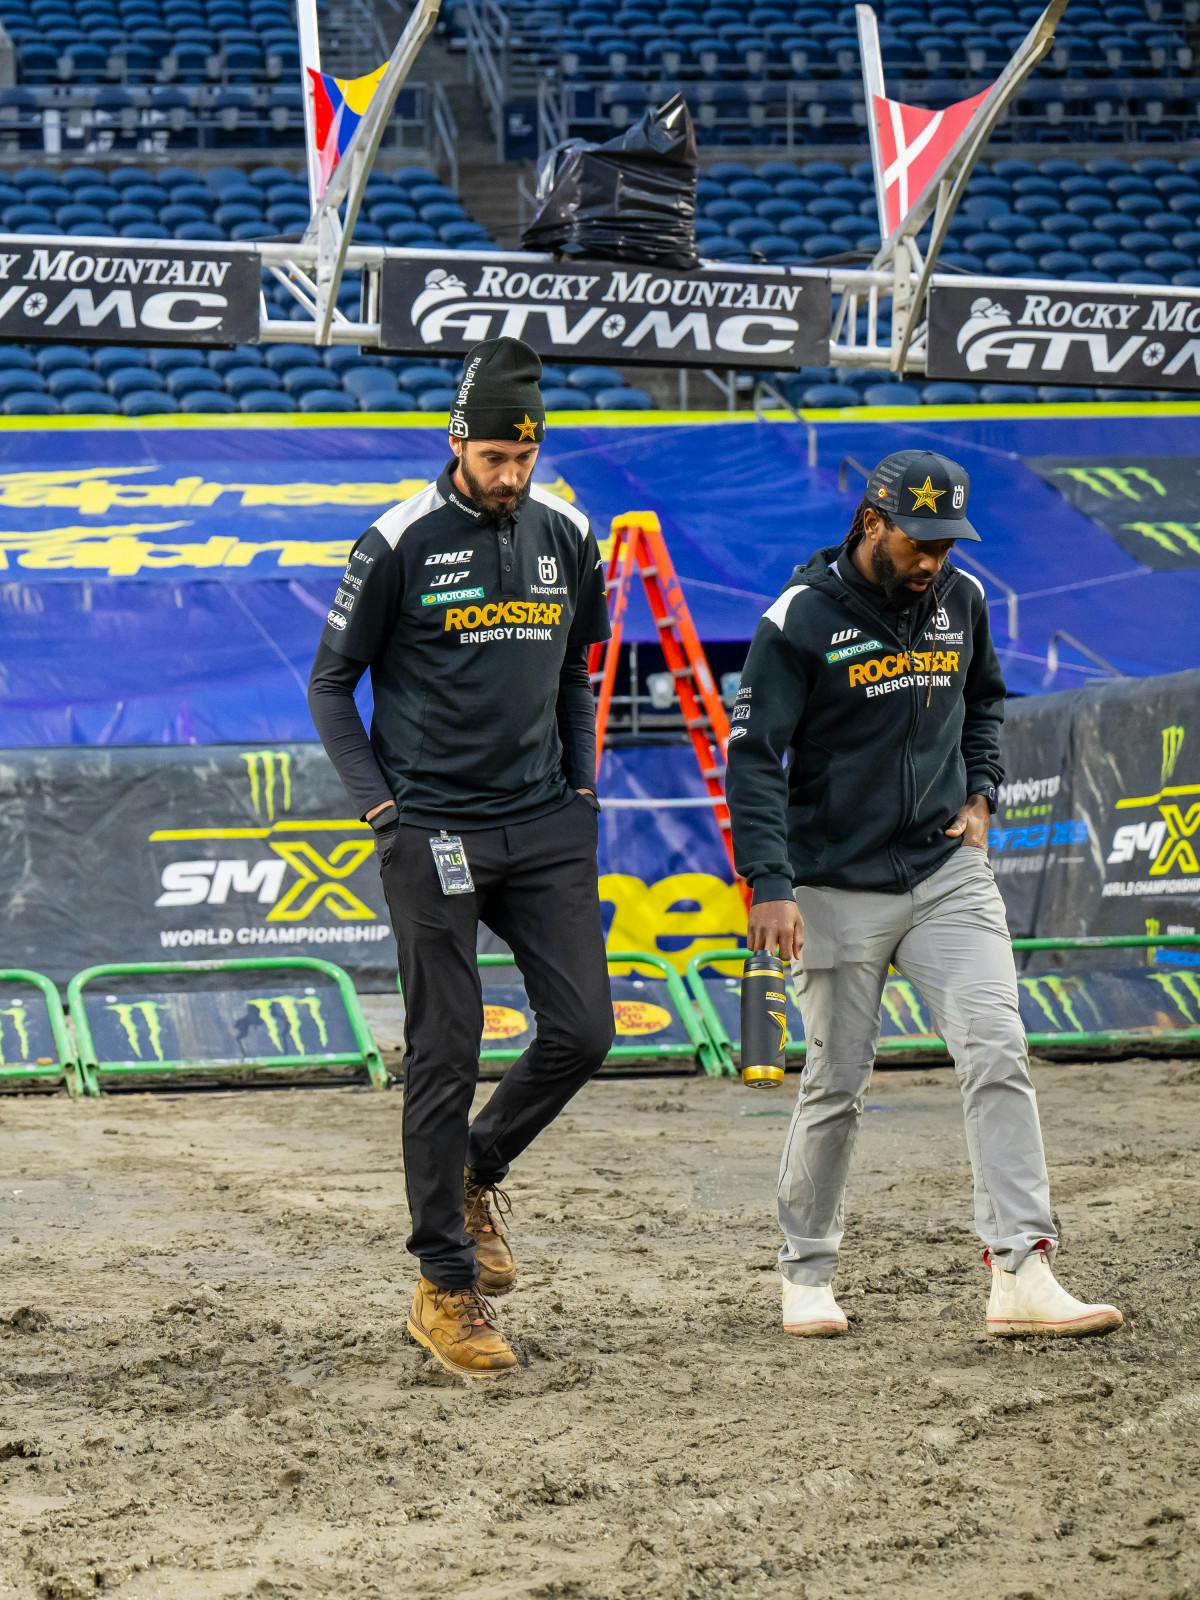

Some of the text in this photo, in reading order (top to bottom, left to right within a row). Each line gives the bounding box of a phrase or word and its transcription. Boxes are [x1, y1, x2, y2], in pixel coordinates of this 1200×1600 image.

[26, 249, 232, 287] MOUNTAIN
[473, 266, 802, 311] ROCKY MOUNTAIN
[1017, 294, 1140, 330] ROCKY
[437, 587, 482, 602] MOTOREX
[444, 601, 562, 632] ROCKSTAR
[460, 628, 552, 644] ENERGY DRINK
[839, 640, 881, 658] MOTOREX
[849, 651, 959, 688] ROCKSTAR
[866, 675, 915, 698] ENERGY
[155, 841, 378, 922] SMX
[160, 925, 390, 948] WORLD CHAMPIONSHIP
